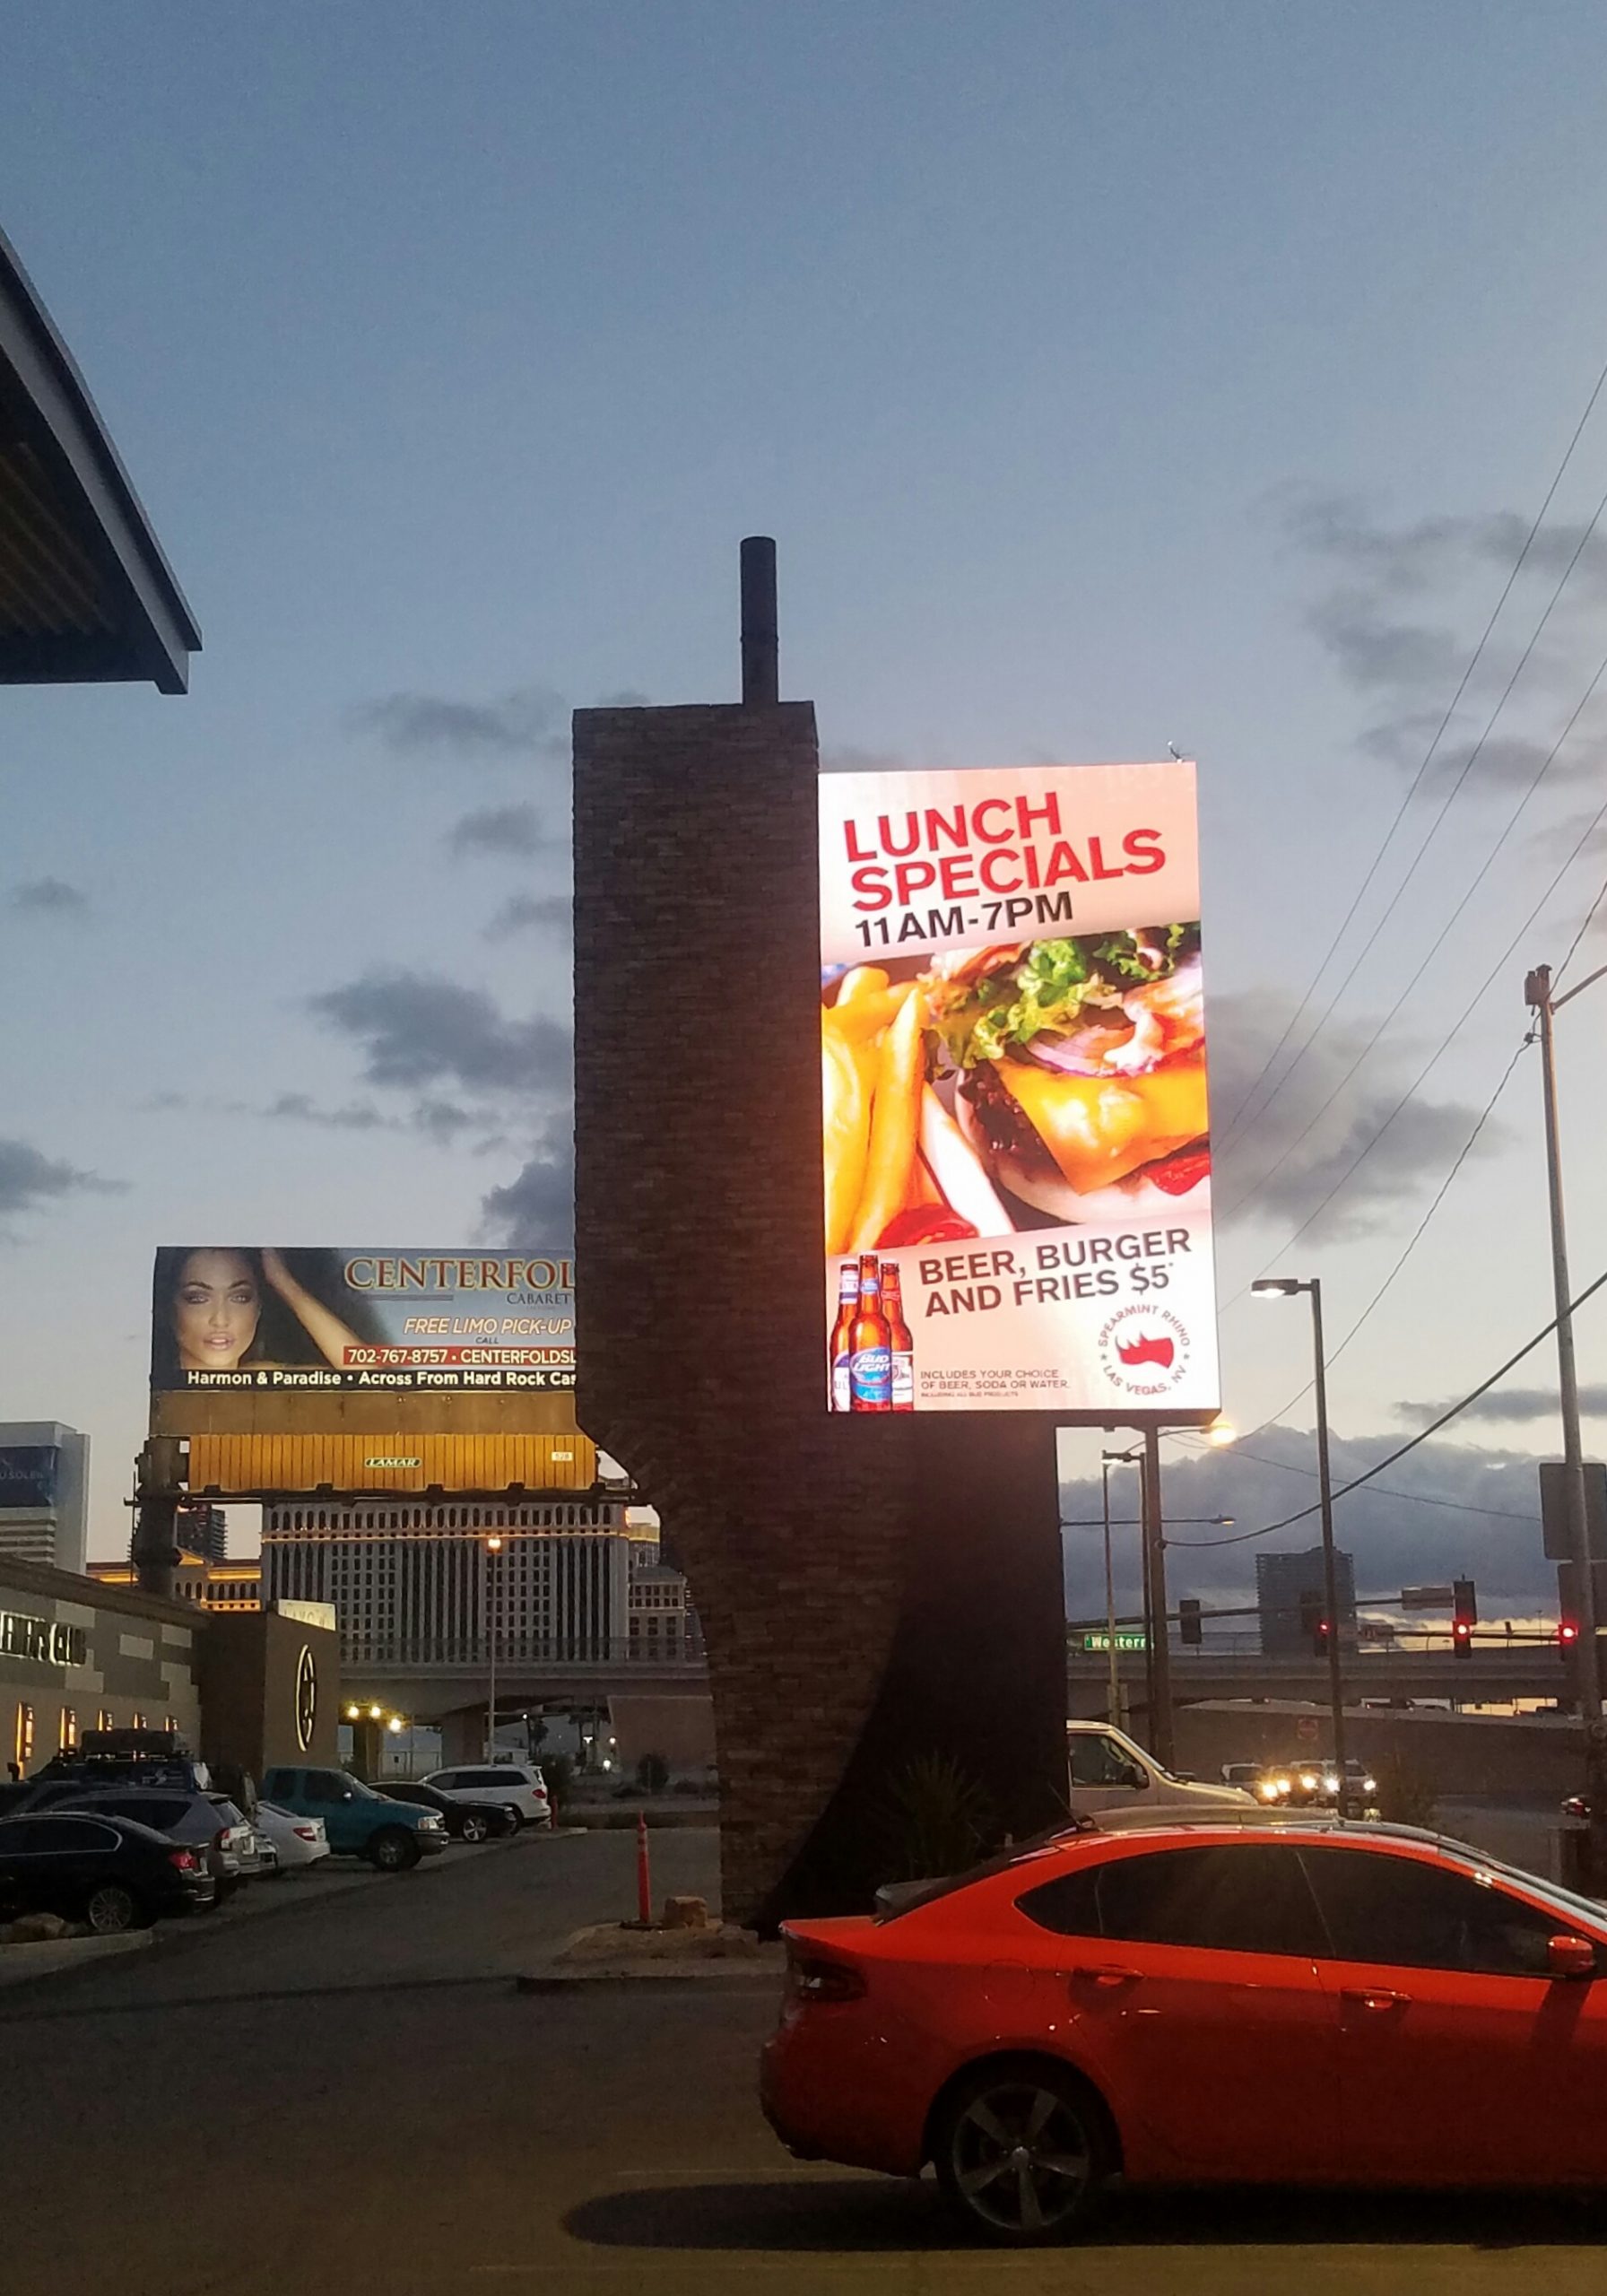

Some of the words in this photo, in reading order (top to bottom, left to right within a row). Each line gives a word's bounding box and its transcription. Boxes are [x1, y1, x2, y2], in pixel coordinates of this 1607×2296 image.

[843, 791, 1062, 863] LUNCH
[851, 828, 1166, 911] SPECIALS
[855, 891, 1074, 948] 11AM-7PM
[919, 1249, 1027, 1286] BEER,
[1037, 1227, 1192, 1271] BURGER
[506, 1292, 571, 1305] CABARET
[925, 1284, 1002, 1318] AND
[1014, 1268, 1119, 1307] FRIES
[404, 1318, 450, 1335] FREE
[452, 1318, 497, 1335] LIMO
[500, 1318, 572, 1335] PICK-UP
[1099, 1304, 1159, 1347] SPEARMINT
[1161, 1309, 1190, 1346] RHINO
[475, 1336, 499, 1344] CALL
[348, 1349, 447, 1363] 702-767-8757
[187, 1371, 252, 1385] Harmon
[256, 1371, 268, 1385] &
[273, 1371, 341, 1385] Paradise
[359, 1372, 412, 1385] Across
[417, 1372, 460, 1385] From
[464, 1371, 501, 1385] Hard
[506, 1371, 545, 1385] Rock
[920, 1370, 977, 1379] INCLUDES
[979, 1370, 1012, 1378] YOUR
[1015, 1370, 1059, 1378] CHOICE
[1103, 1365, 1124, 1387] LAS
[921, 1381, 935, 1389] OF
[976, 1380, 1007, 1389] SODA
[1011, 1380, 1027, 1388] OR
[369, 1458, 416, 1467] LAMAR
